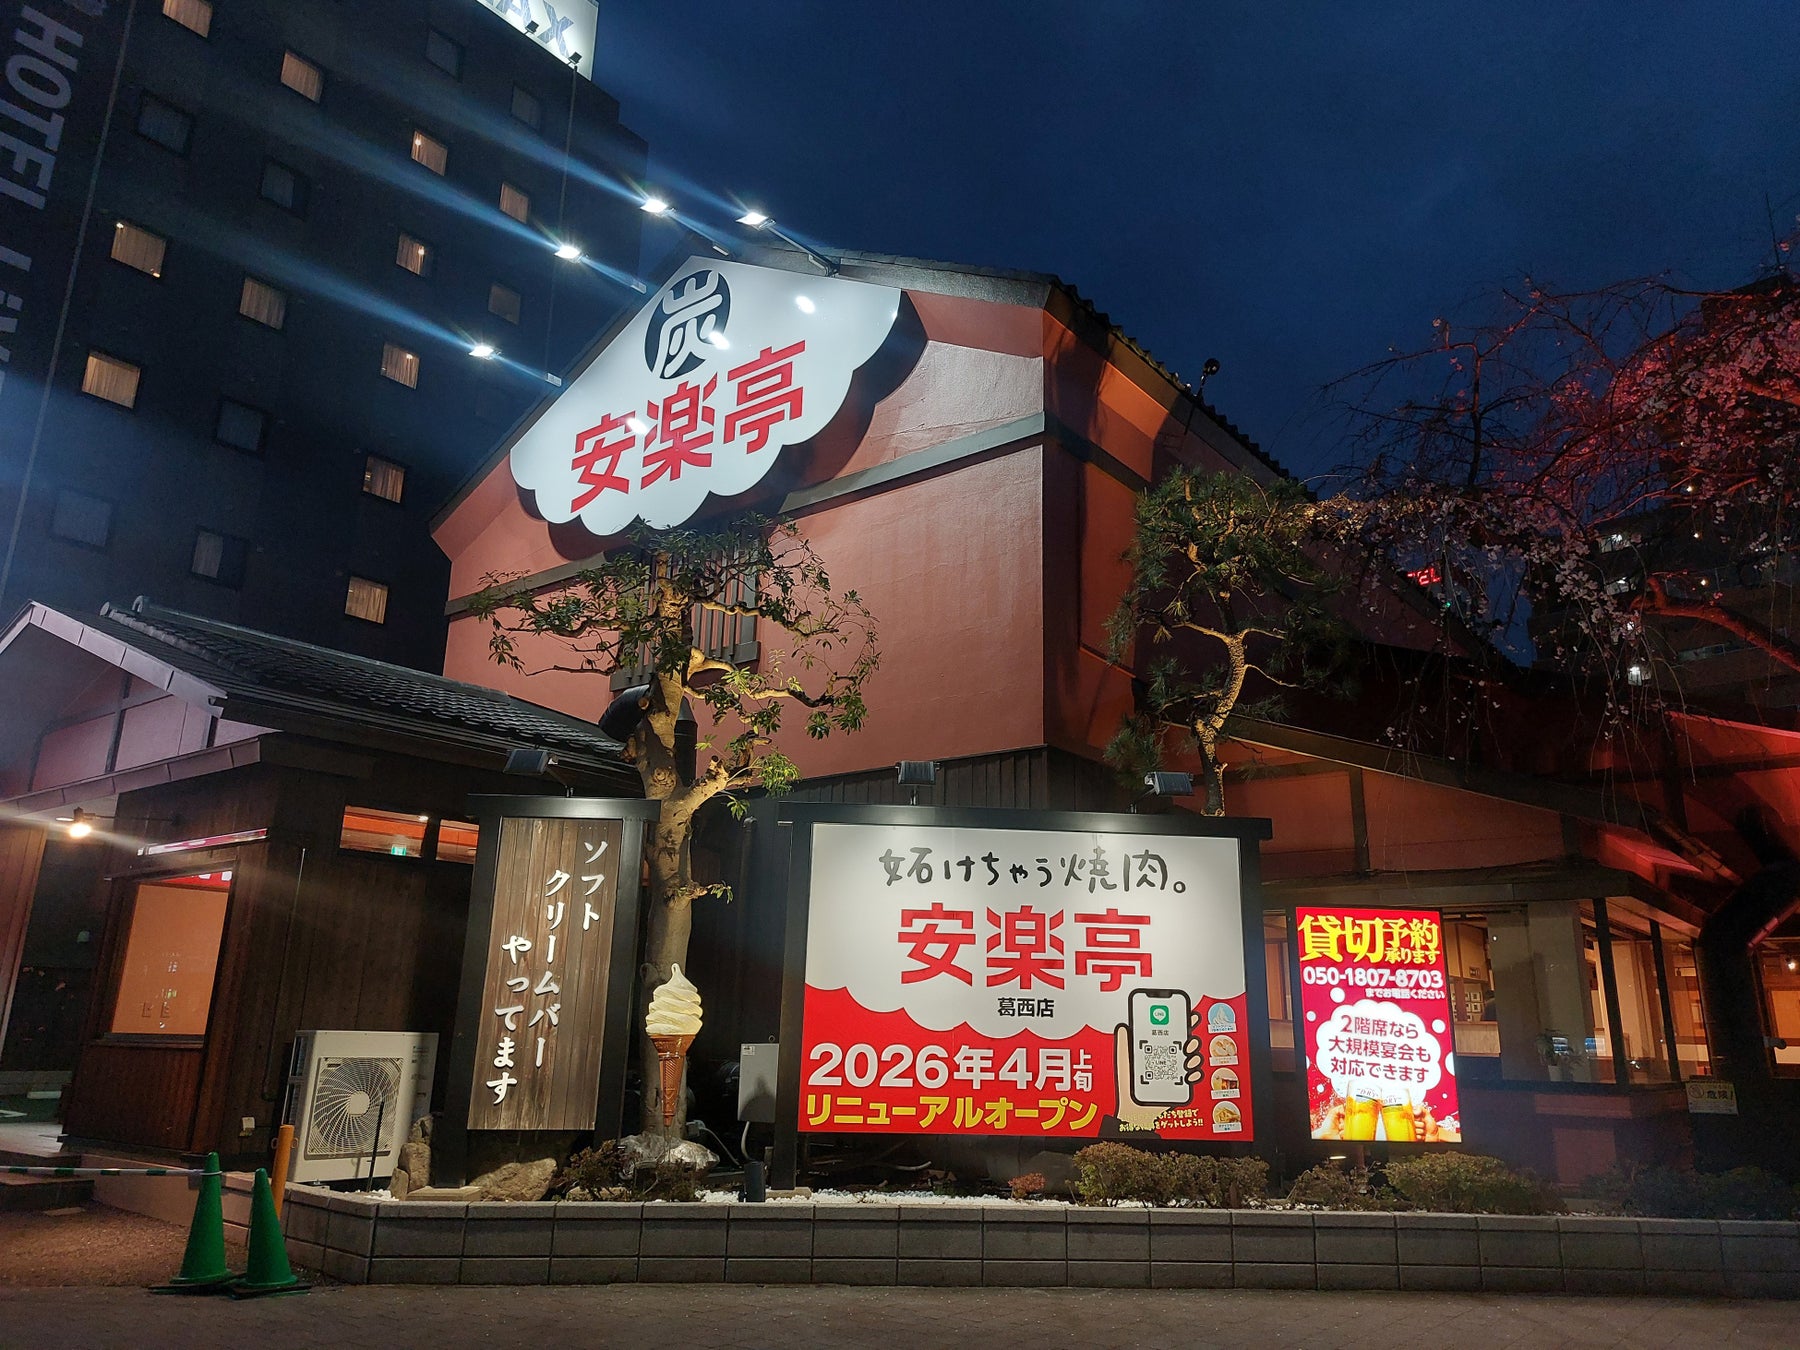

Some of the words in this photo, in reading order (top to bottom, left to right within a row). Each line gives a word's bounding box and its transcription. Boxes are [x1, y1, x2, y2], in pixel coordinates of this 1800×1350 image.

[481, 0, 574, 58] AX
[648, 270, 730, 379] 炭
[571, 339, 806, 513] 安楽亭
[581, 840, 609, 931] ソフト
[878, 846, 1187, 894] 妬けちゃう焼肉。
[897, 902, 1153, 992] 安楽亭
[1297, 914, 1439, 963] 貸切予約
[1384, 947, 1440, 965] 承ります
[528, 869, 571, 1068] クリームバー
[1303, 966, 1444, 988] 050-1807-8703
[486, 935, 532, 1105] やってます
[997, 997, 1055, 1019] 葛西店
[1340, 1014, 1420, 1039] 2階席なら
[1328, 1036, 1432, 1063] 大規模宴会も
[1330, 1056, 1430, 1083] 対応できます
[807, 1095, 1098, 1131] リニューアルオープン
